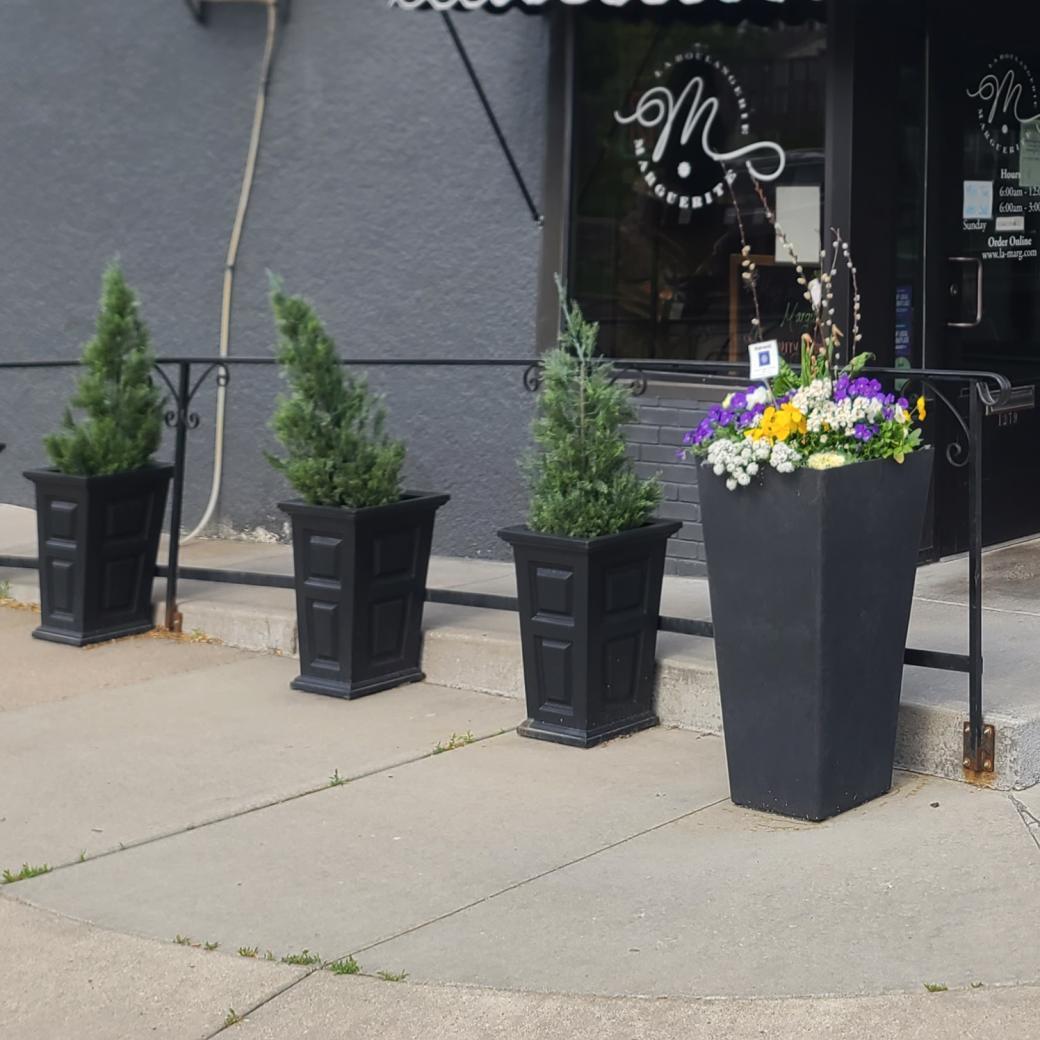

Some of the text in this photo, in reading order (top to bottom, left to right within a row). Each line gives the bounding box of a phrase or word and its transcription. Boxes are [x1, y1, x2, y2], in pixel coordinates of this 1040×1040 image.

[633, 138, 737, 209] MARGUERITE
[999, 186, 1023, 197] 6:00am
[999, 202, 1023, 213] 6:00am
[962, 219, 987, 233] Sunday
[987, 235, 1032, 247] Order Online
[981, 248, 1037, 261] www.la-marg.com
